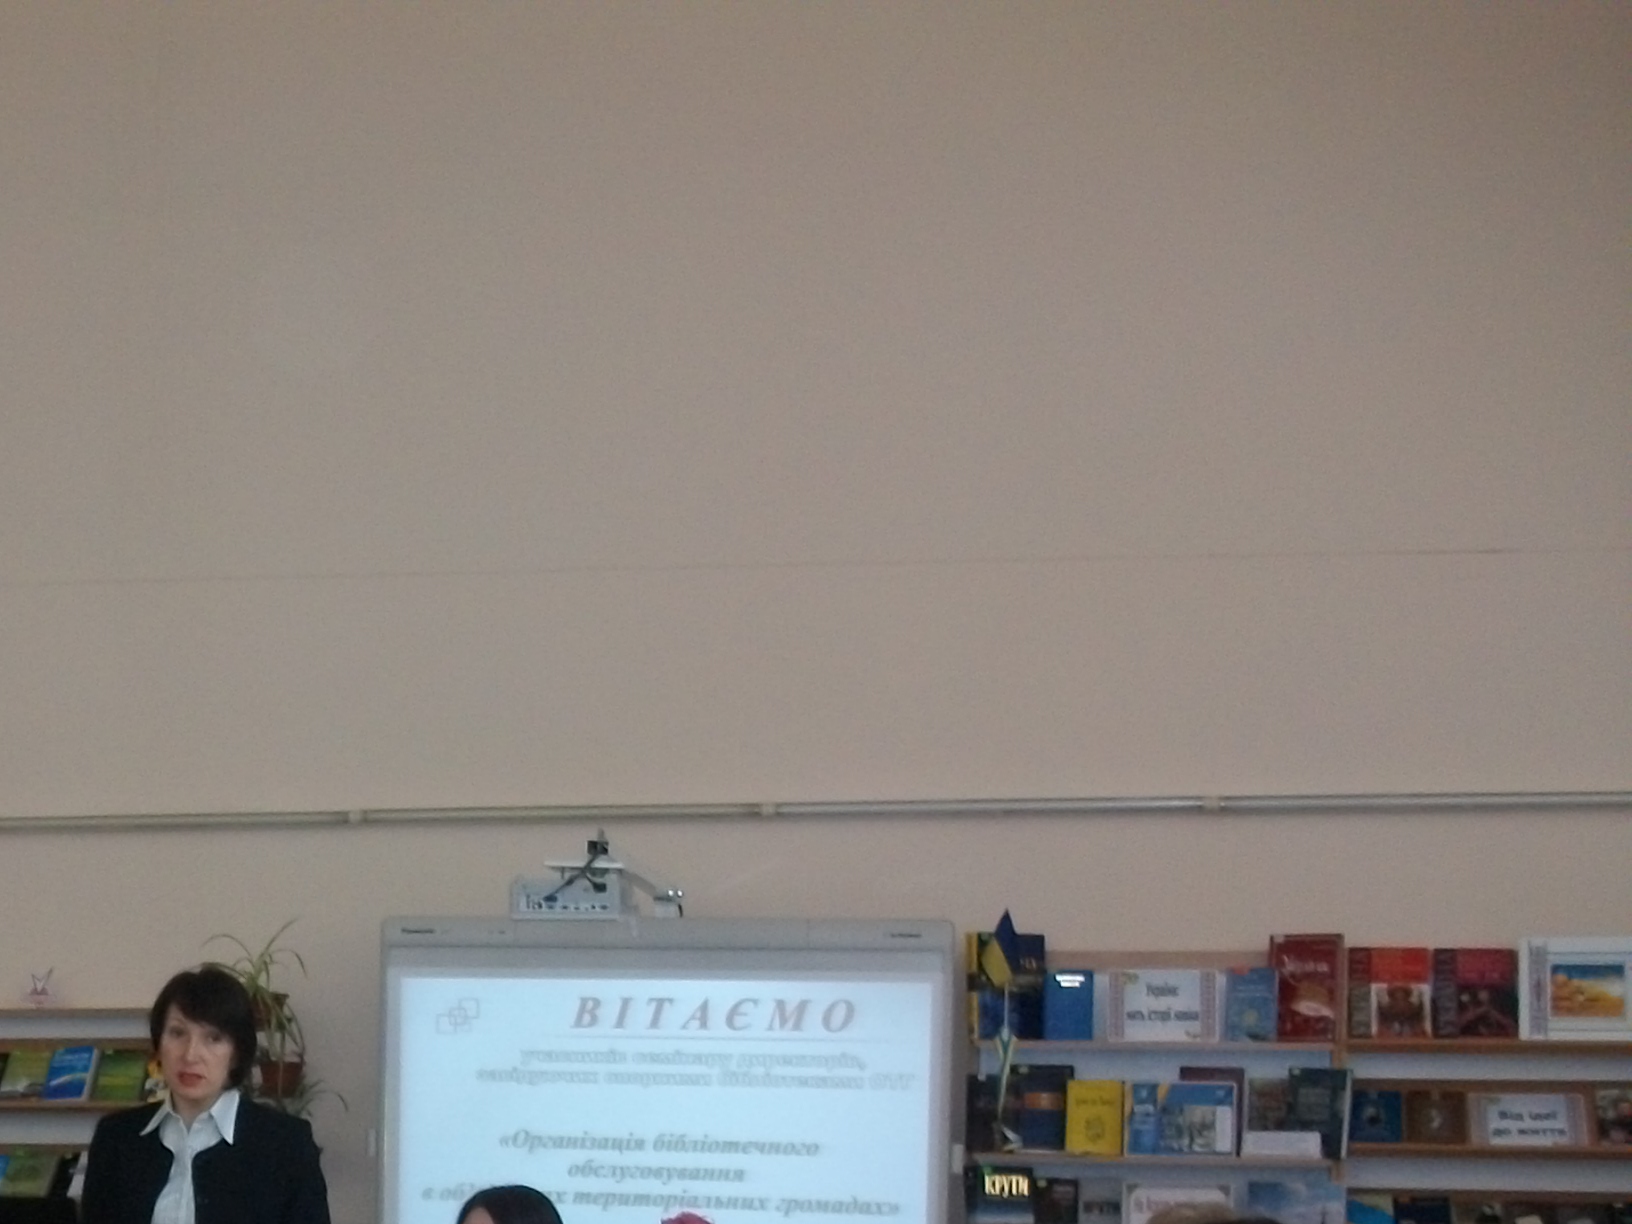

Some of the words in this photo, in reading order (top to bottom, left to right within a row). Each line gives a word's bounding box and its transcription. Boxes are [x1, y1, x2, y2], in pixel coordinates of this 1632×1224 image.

[652, 1134, 821, 1156] бібліотечного
[567, 1159, 746, 1185] обслуговування
[571, 1189, 770, 1212] територіальних
